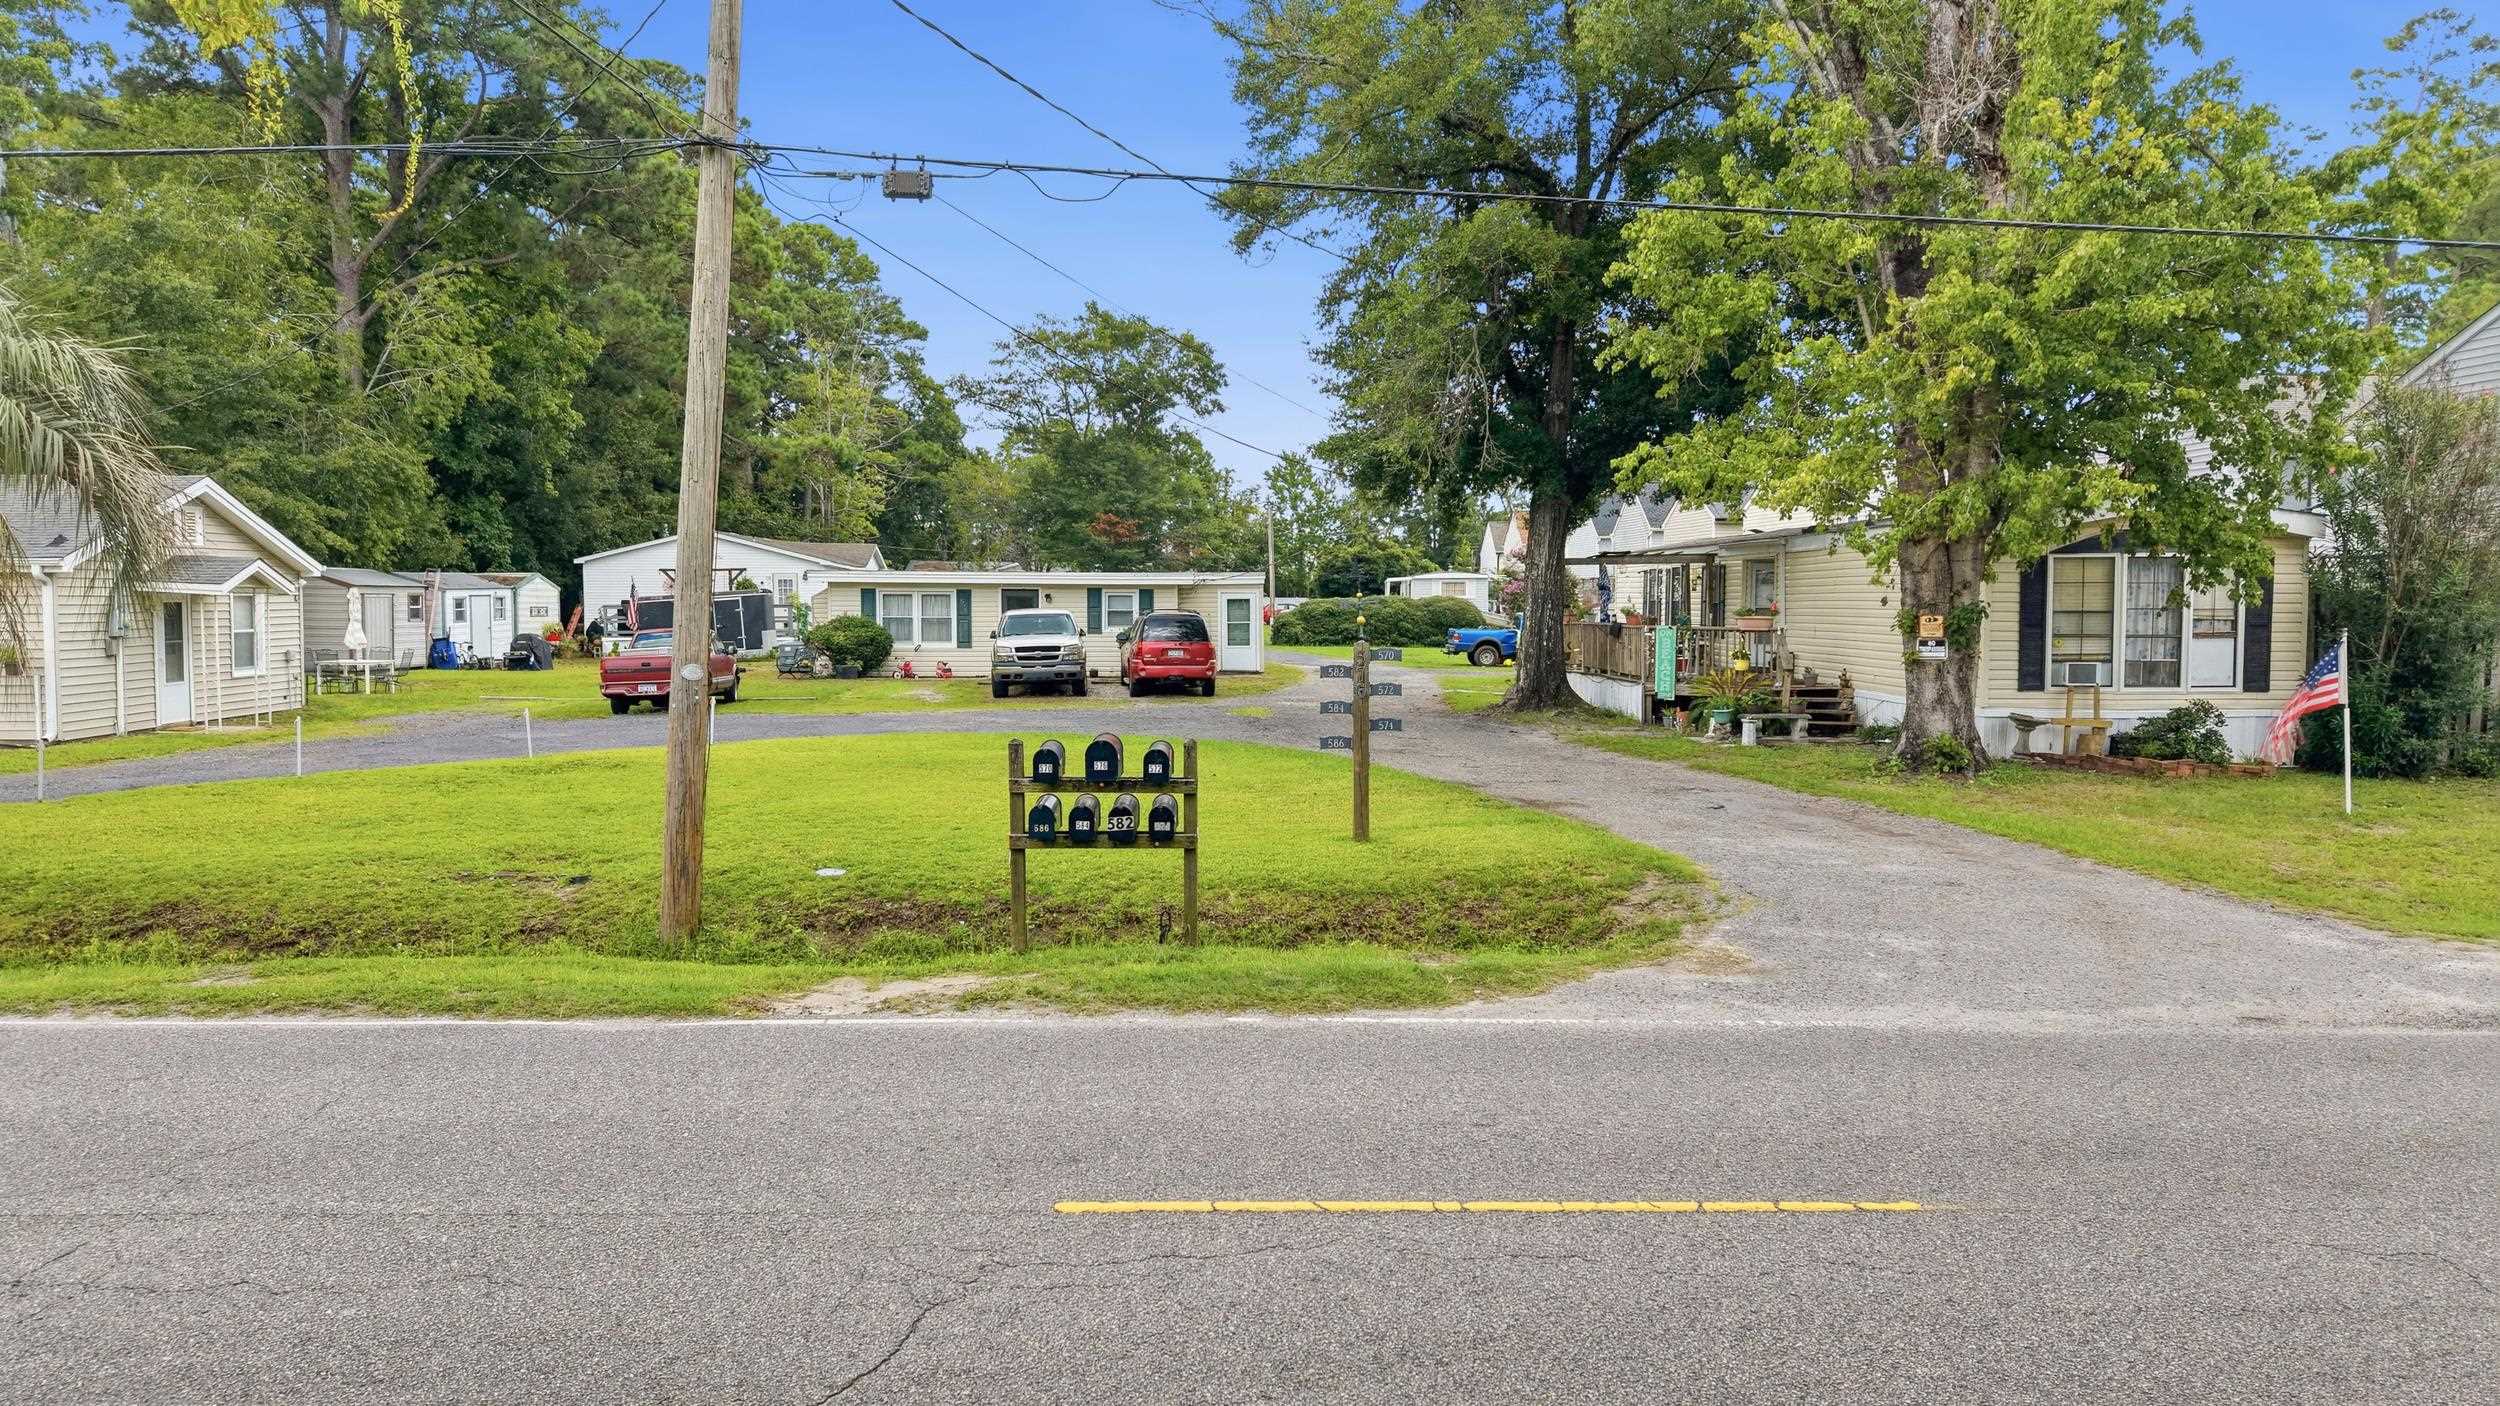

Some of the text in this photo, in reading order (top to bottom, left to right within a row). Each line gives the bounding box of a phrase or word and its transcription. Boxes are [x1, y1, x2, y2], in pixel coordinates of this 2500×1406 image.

[1378, 651, 1394, 660] 570
[1328, 667, 1344, 677] 582
[1378, 685, 1394, 695] 572
[1378, 720, 1393, 730] 574
[1328, 739, 1344, 748] 586
[1107, 816, 1134, 830] 582
[1034, 824, 1050, 833] 586
